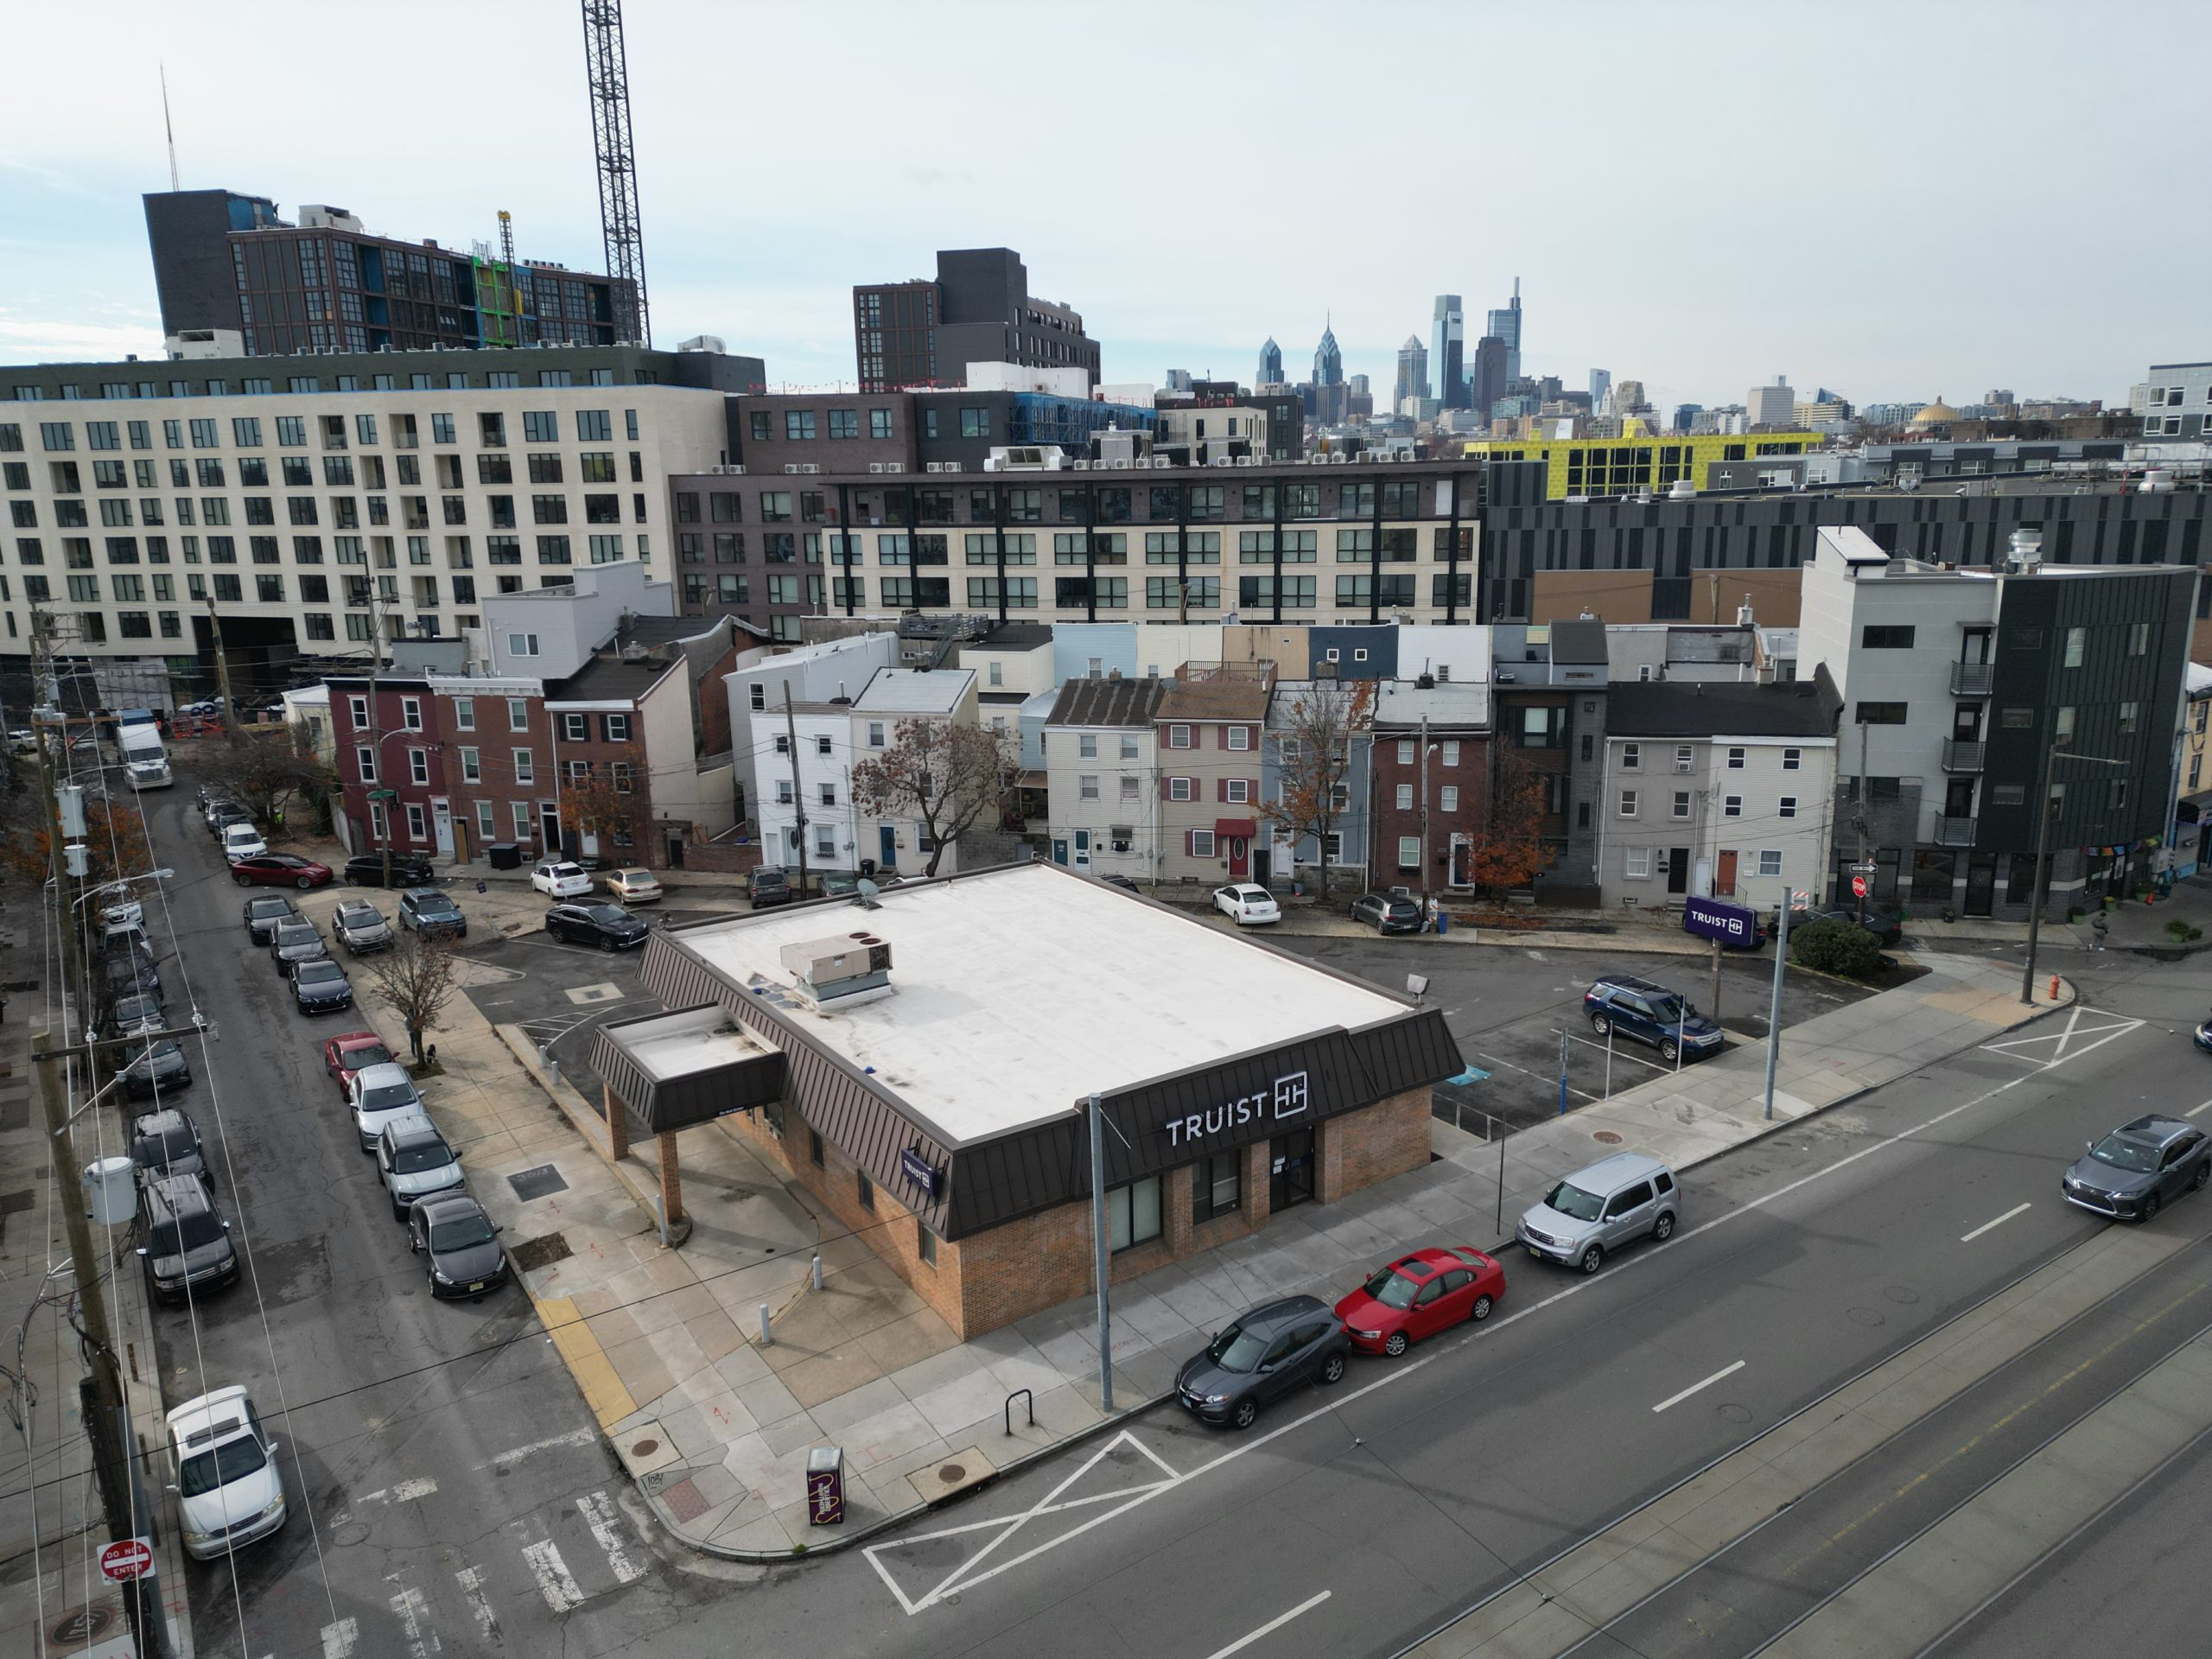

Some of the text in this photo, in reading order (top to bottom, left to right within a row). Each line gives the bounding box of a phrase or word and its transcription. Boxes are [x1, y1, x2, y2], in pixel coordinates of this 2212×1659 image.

[1691, 911, 1727, 928] TRUIST
[1166, 1091, 1268, 1147] TRUIST
[904, 1160, 922, 1179] TRUIST
[106, 1545, 143, 1559] DO NOT
[113, 1564, 143, 1575] ENTER
